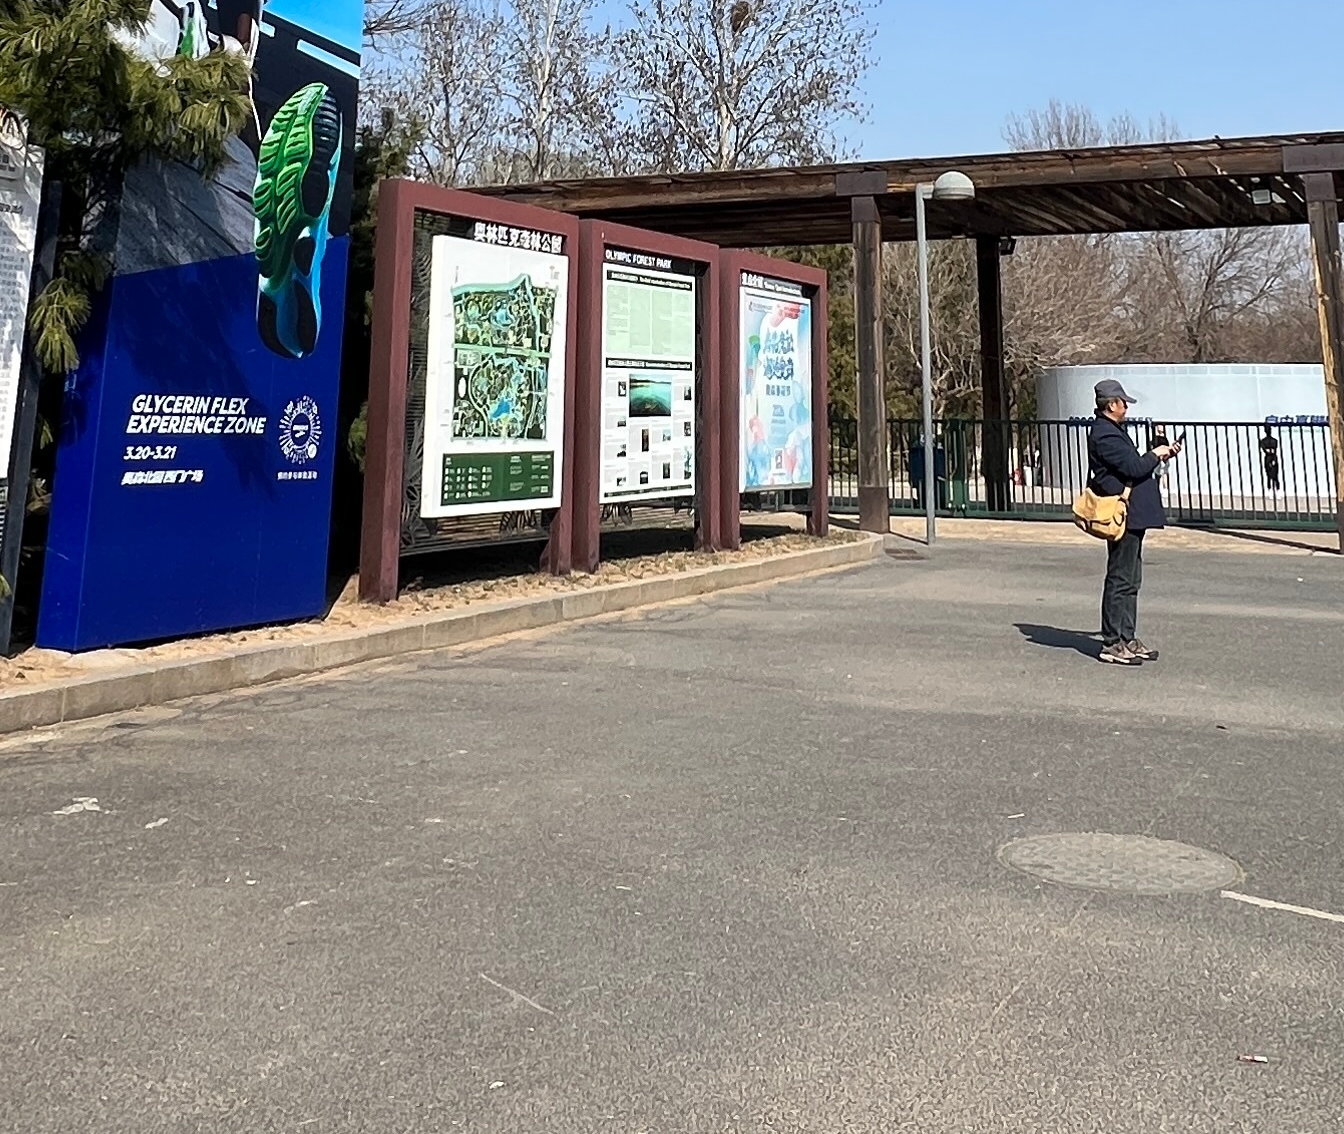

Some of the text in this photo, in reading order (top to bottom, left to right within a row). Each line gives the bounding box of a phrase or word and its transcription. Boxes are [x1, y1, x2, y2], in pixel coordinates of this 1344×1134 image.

[474, 222, 563, 254] 奥林匹克森林公园
[605, 249, 672, 269] OLYMPIC FOREST PARK
[132, 395, 249, 415] GLYCERIN FLEX
[126, 415, 267, 434] EXPERIENCE ZONE
[123, 445, 177, 460] 3.20-3.21
